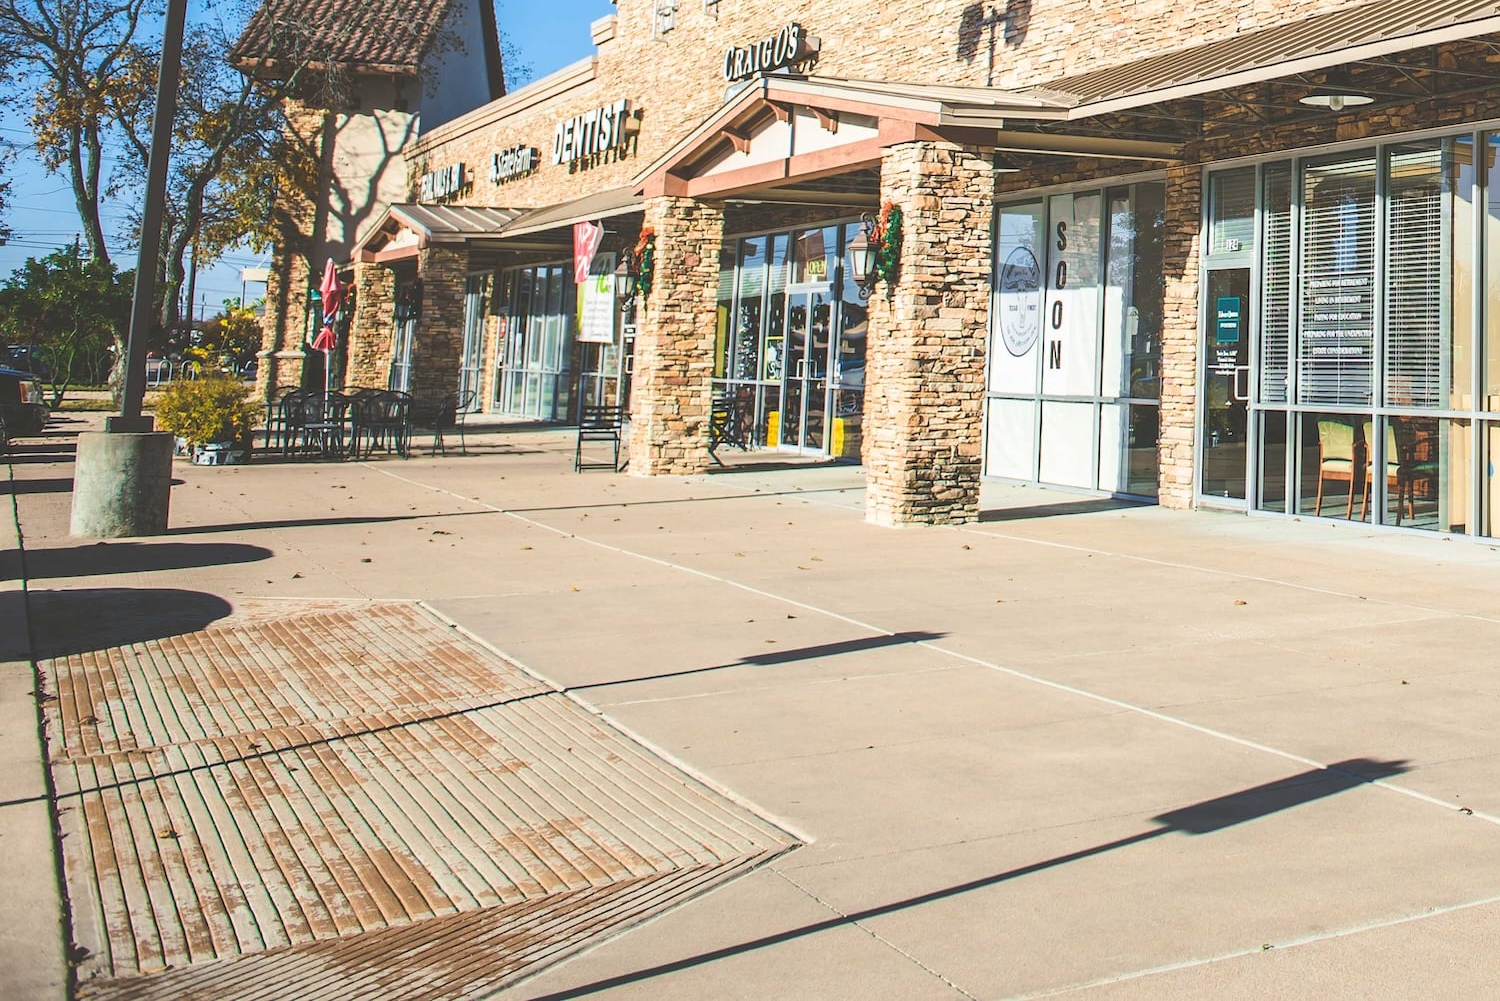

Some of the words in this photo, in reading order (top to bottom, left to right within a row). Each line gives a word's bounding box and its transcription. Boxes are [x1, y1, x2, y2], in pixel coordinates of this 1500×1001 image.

[724, 21, 800, 82] CRAIGO'S
[552, 98, 627, 166] DENTIST
[1049, 220, 1067, 370] SOON
